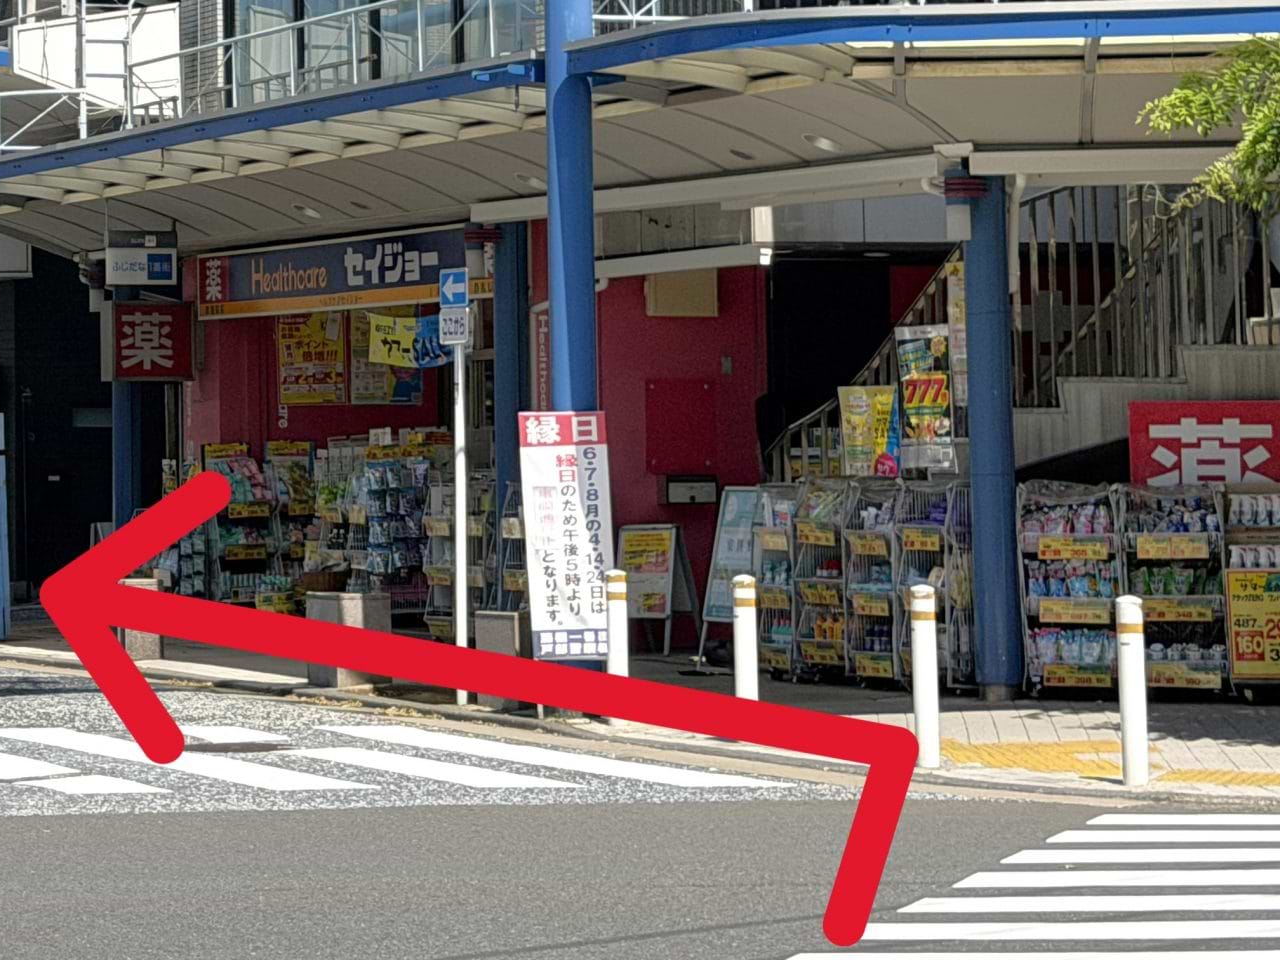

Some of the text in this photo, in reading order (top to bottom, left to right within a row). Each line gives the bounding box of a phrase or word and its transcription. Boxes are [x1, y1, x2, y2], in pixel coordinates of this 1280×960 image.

[205, 258, 222, 302] 薬
[251, 258, 328, 294] Healthcare
[344, 241, 439, 287] セイジョー
[120, 312, 174, 371] 薬
[525, 415, 598, 444] 縁日
[1236, 635, 1264, 654] 160
